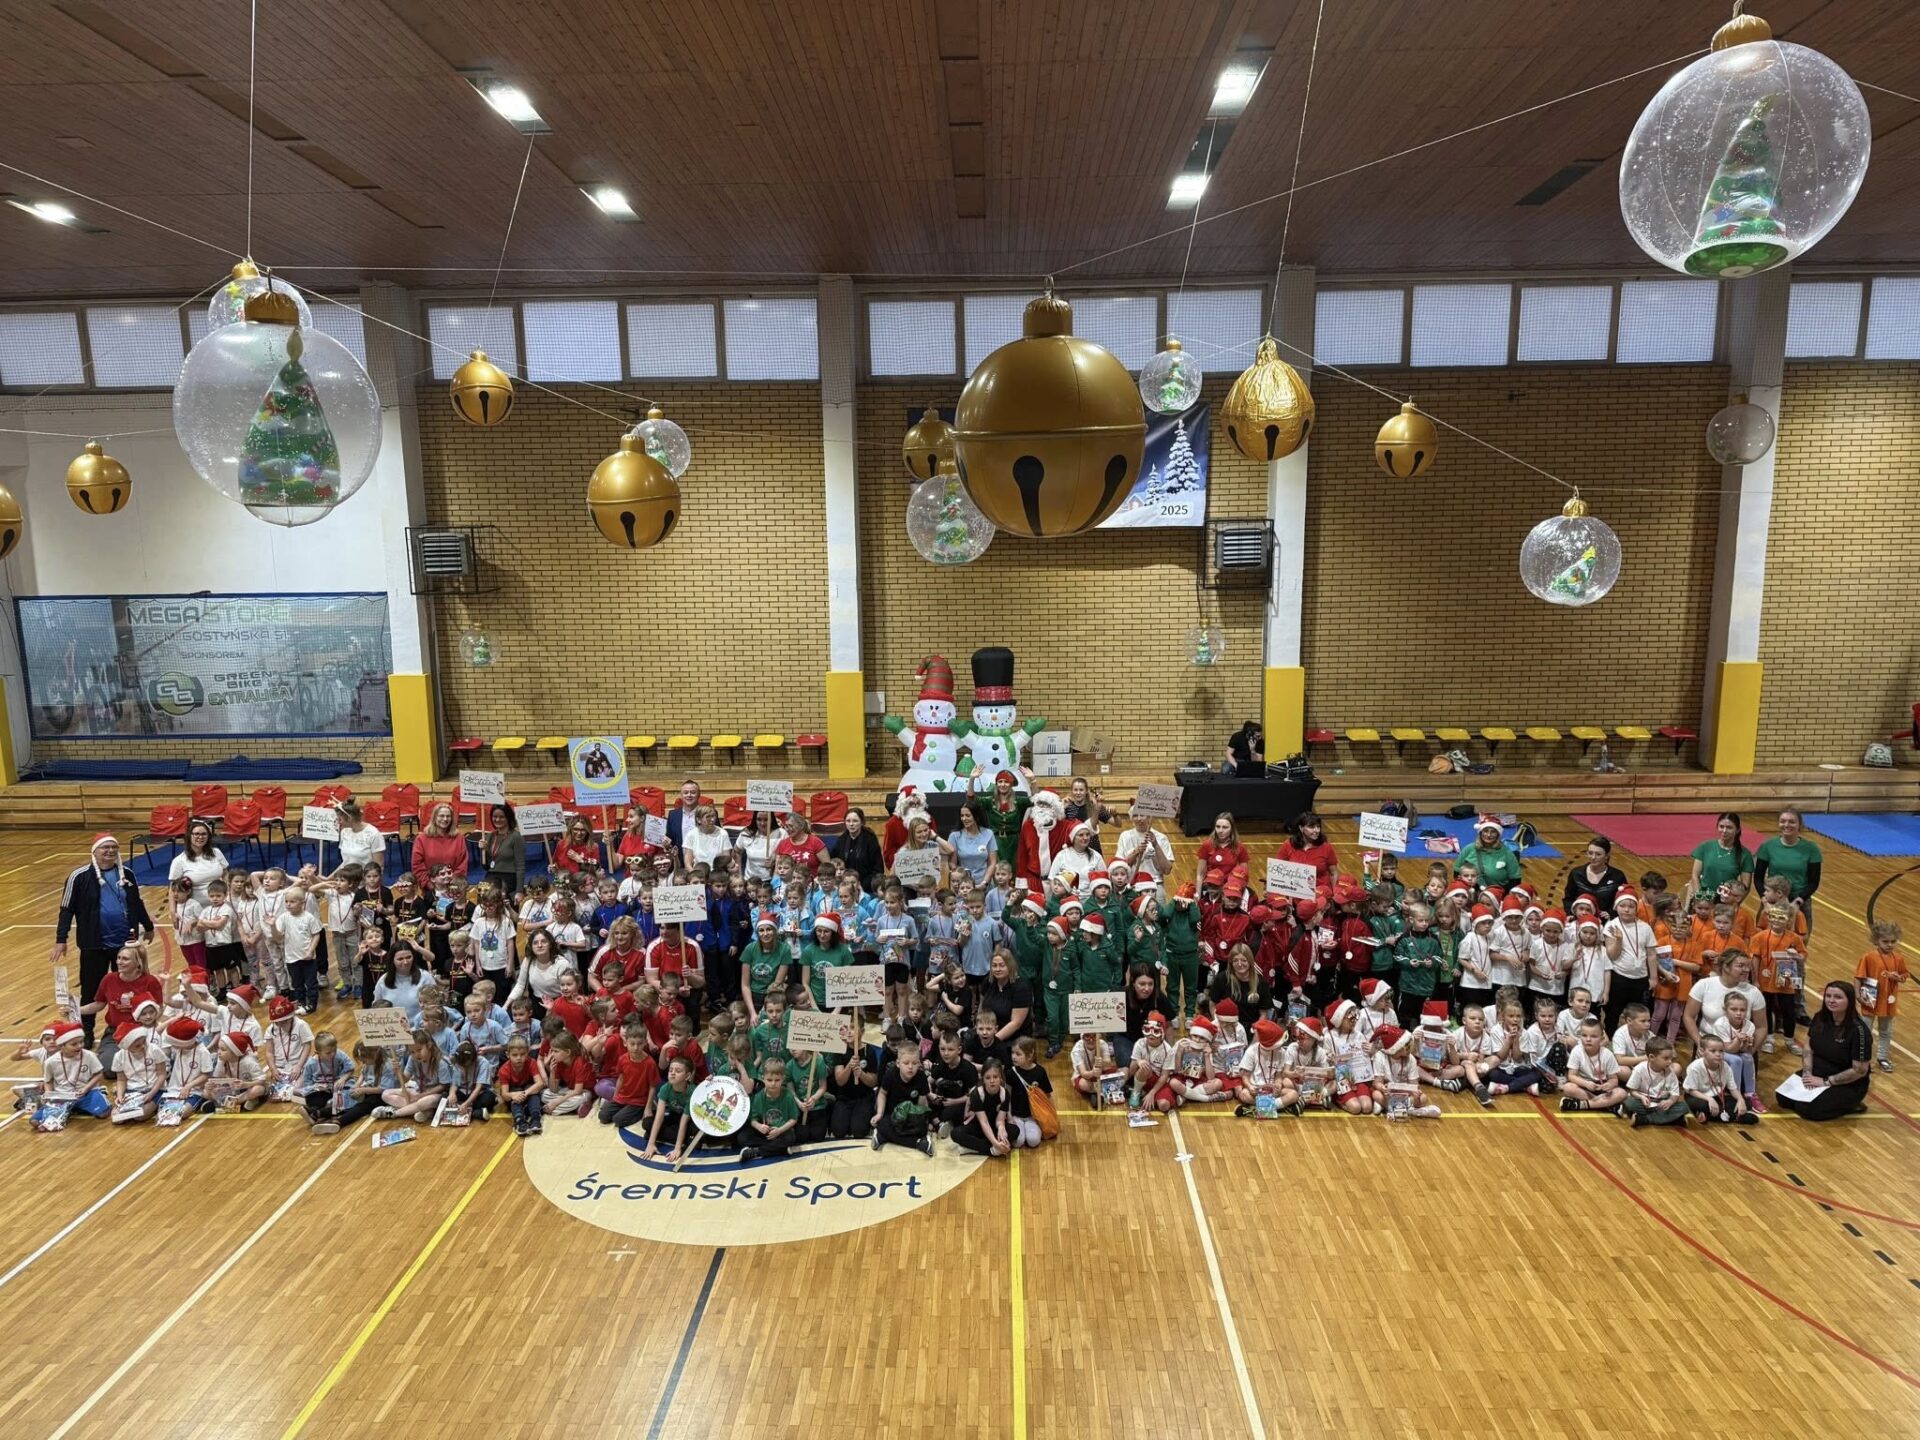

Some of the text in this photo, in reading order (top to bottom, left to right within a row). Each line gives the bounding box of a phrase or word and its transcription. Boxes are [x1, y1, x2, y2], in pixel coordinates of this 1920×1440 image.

[1160, 504, 1189, 516] 2025
[182, 629, 270, 642] GOSTYŃSKA
[214, 670, 273, 682] GREEN
[226, 680, 263, 689] BIKE
[207, 686, 294, 706] EXTRALIGA
[566, 1171, 923, 1206] Śremski Sport
